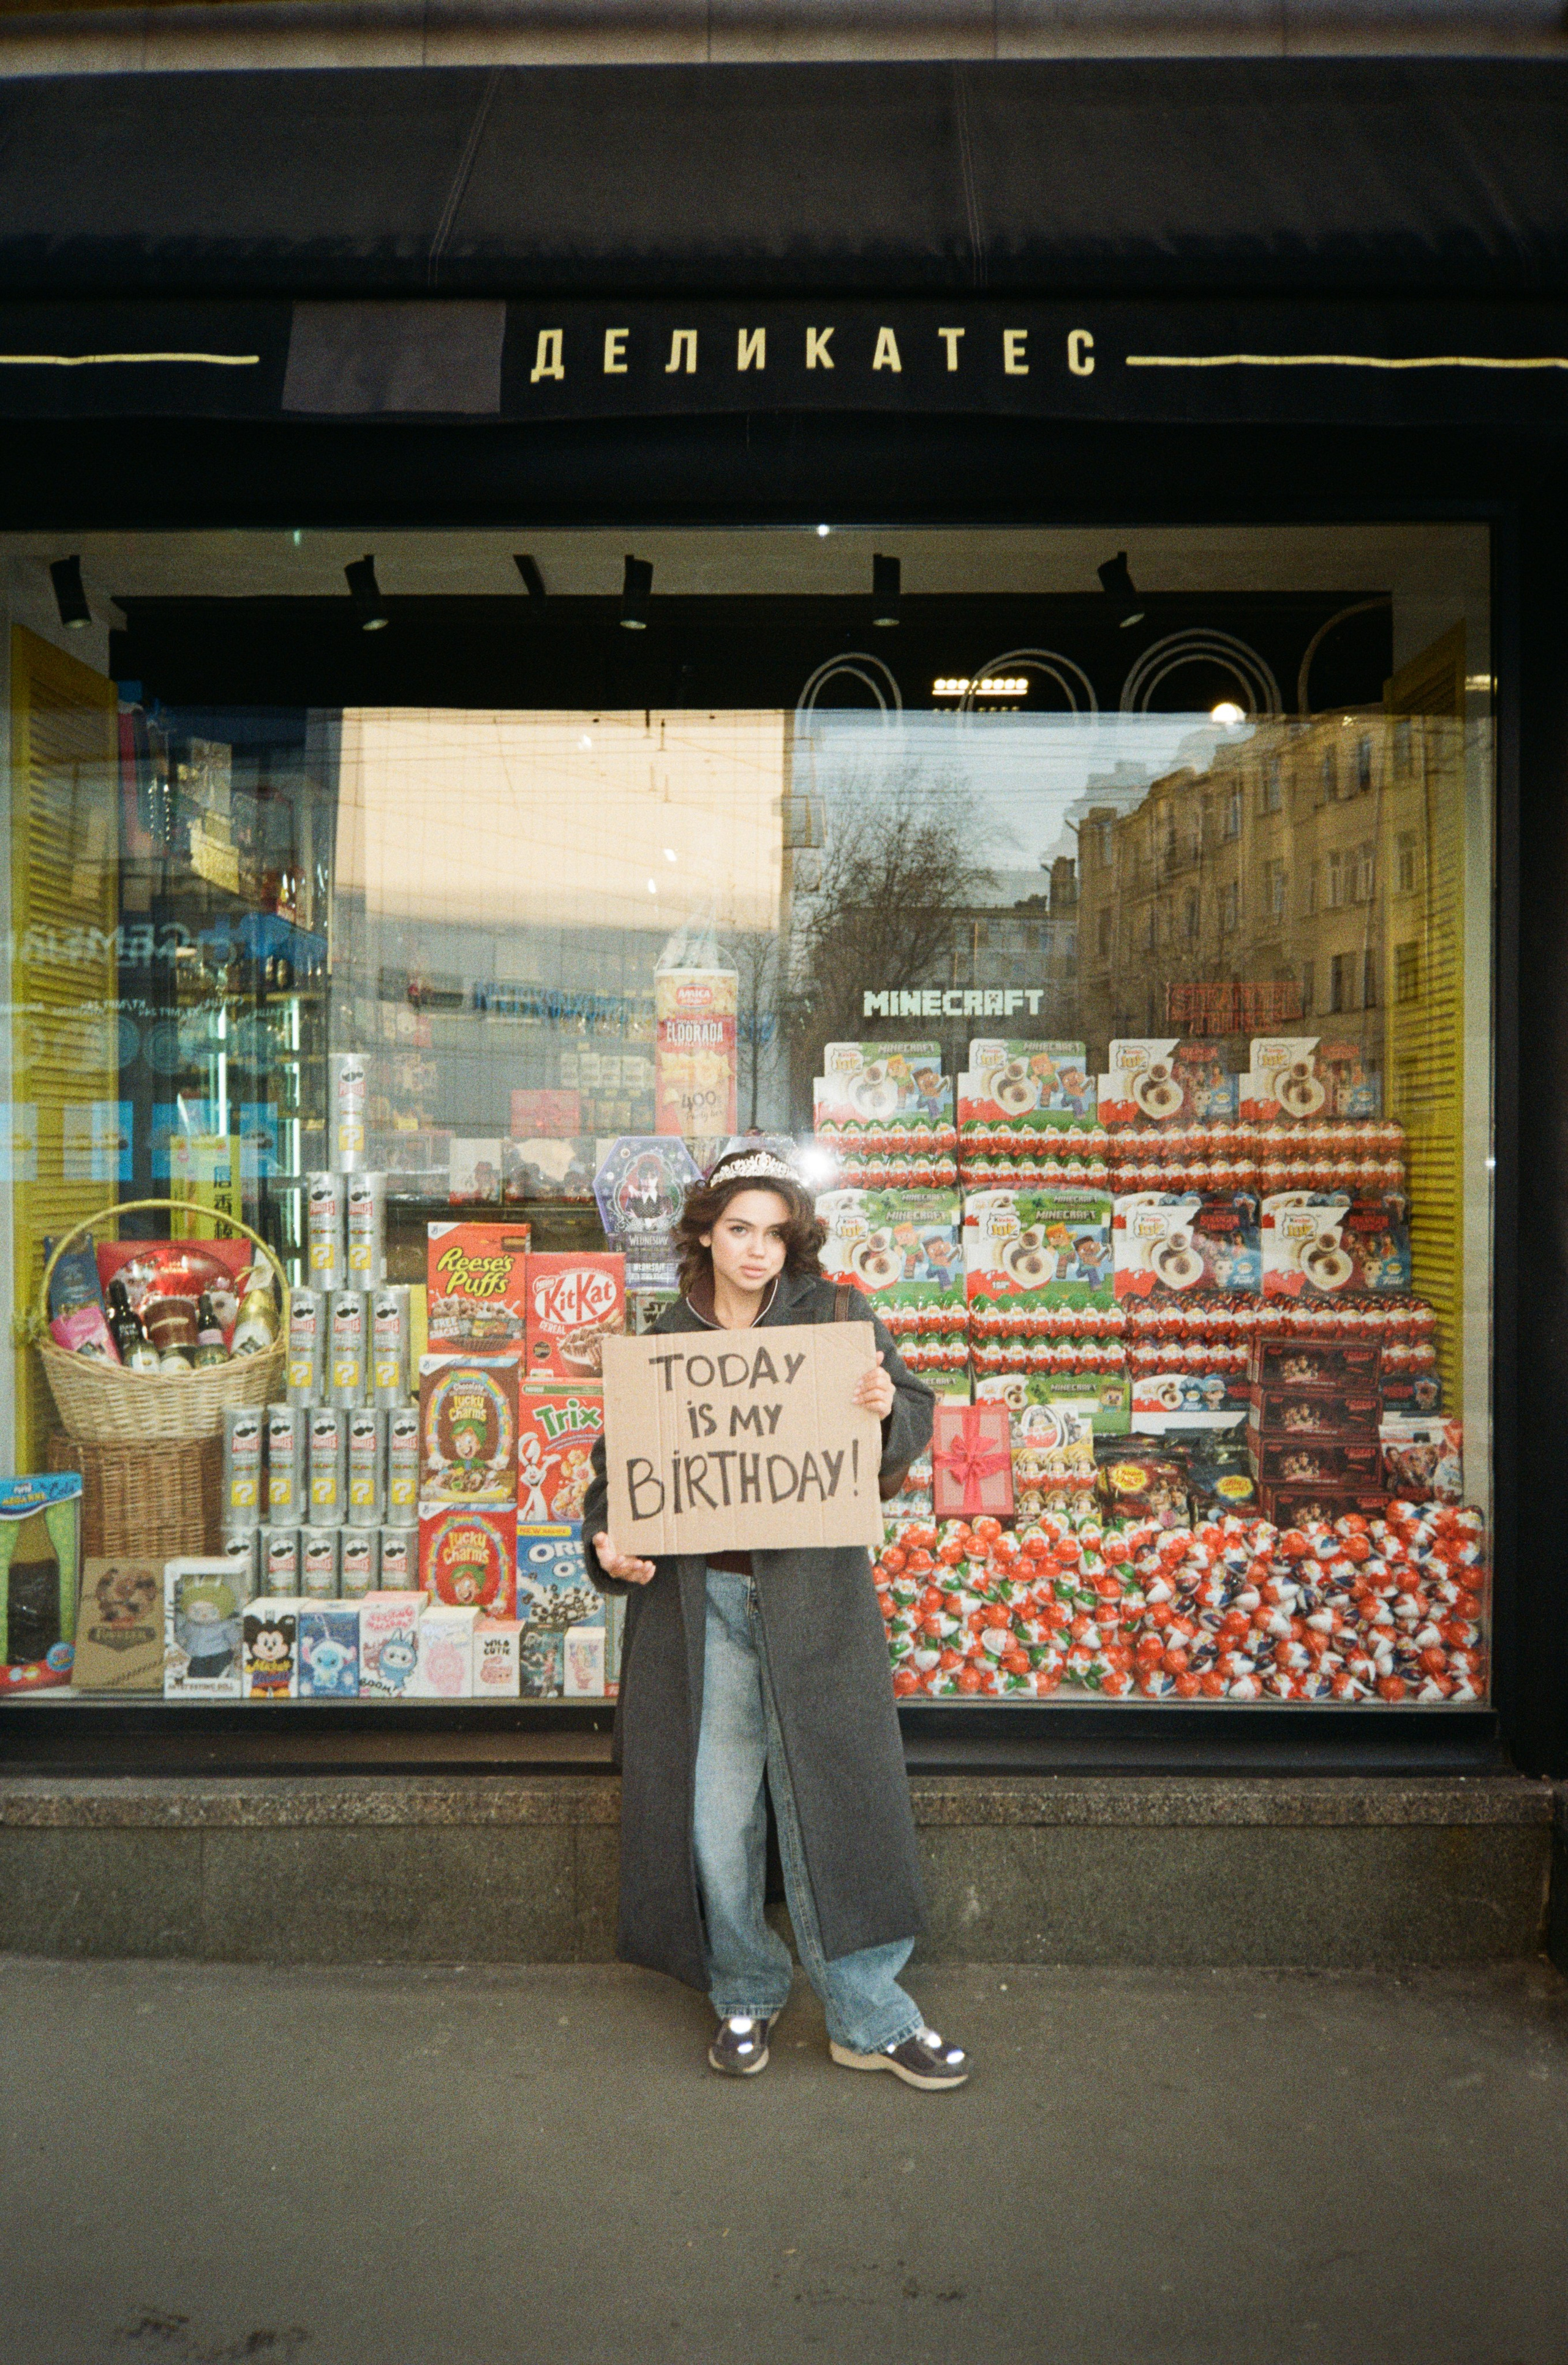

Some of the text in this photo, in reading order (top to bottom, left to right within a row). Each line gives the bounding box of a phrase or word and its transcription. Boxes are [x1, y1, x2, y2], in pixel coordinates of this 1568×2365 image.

[530, 326, 1096, 383] ДЕЛИКАТЕС
[863, 990, 1044, 1017] MINECRAFT
[666, 1021, 723, 1043] ELDORADA
[885, 1211, 947, 1221] MINECRAFT
[1035, 1210, 1096, 1220] MINECRAFT
[629, 1235, 669, 1247] WEDNESDAY
[437, 1247, 514, 1272] Reese's
[446, 1271, 510, 1297] Puffs
[544, 1273, 612, 1322] KitKat
[432, 1316, 458, 1329] FREE
[648, 1346, 807, 1392] TODAY
[1050, 1382, 1097, 1392] MINECRAFT
[532, 1397, 603, 1441] Trix
[729, 1403, 783, 1437] MY
[443, 1544, 490, 1566] Charms
[483, 1647, 511, 1656] CUTIE
